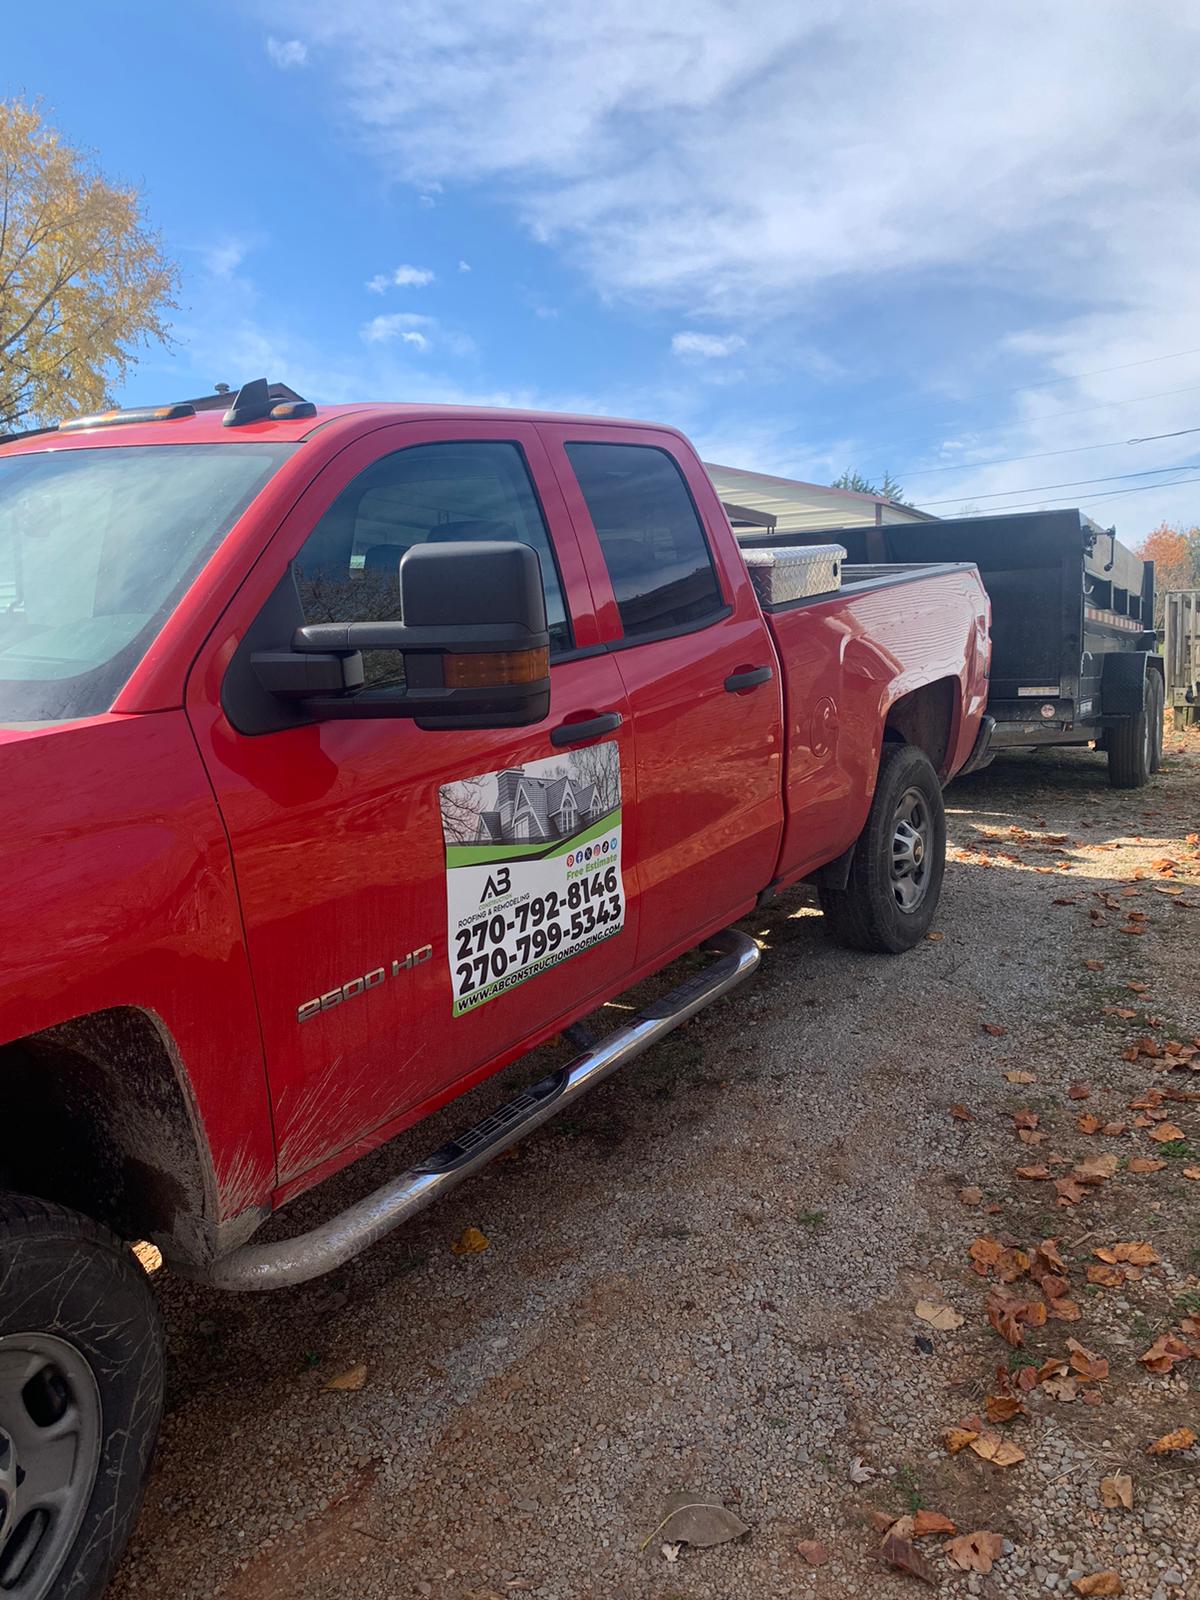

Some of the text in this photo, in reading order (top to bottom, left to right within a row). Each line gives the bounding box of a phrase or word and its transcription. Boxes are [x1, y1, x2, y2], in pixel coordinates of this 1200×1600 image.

[480, 867, 512, 903] AB
[566, 853, 618, 881] Free Estimate
[455, 866, 618, 961] 270-792-8146
[456, 894, 622, 995] 270-799-5343
[458, 912, 487, 928] ROOFING
[493, 892, 531, 914] REMODELING
[297, 943, 433, 1024] 2500 HD
[458, 922, 621, 1011] WWW.ABCONSTRUCTIONROOFING.COM
